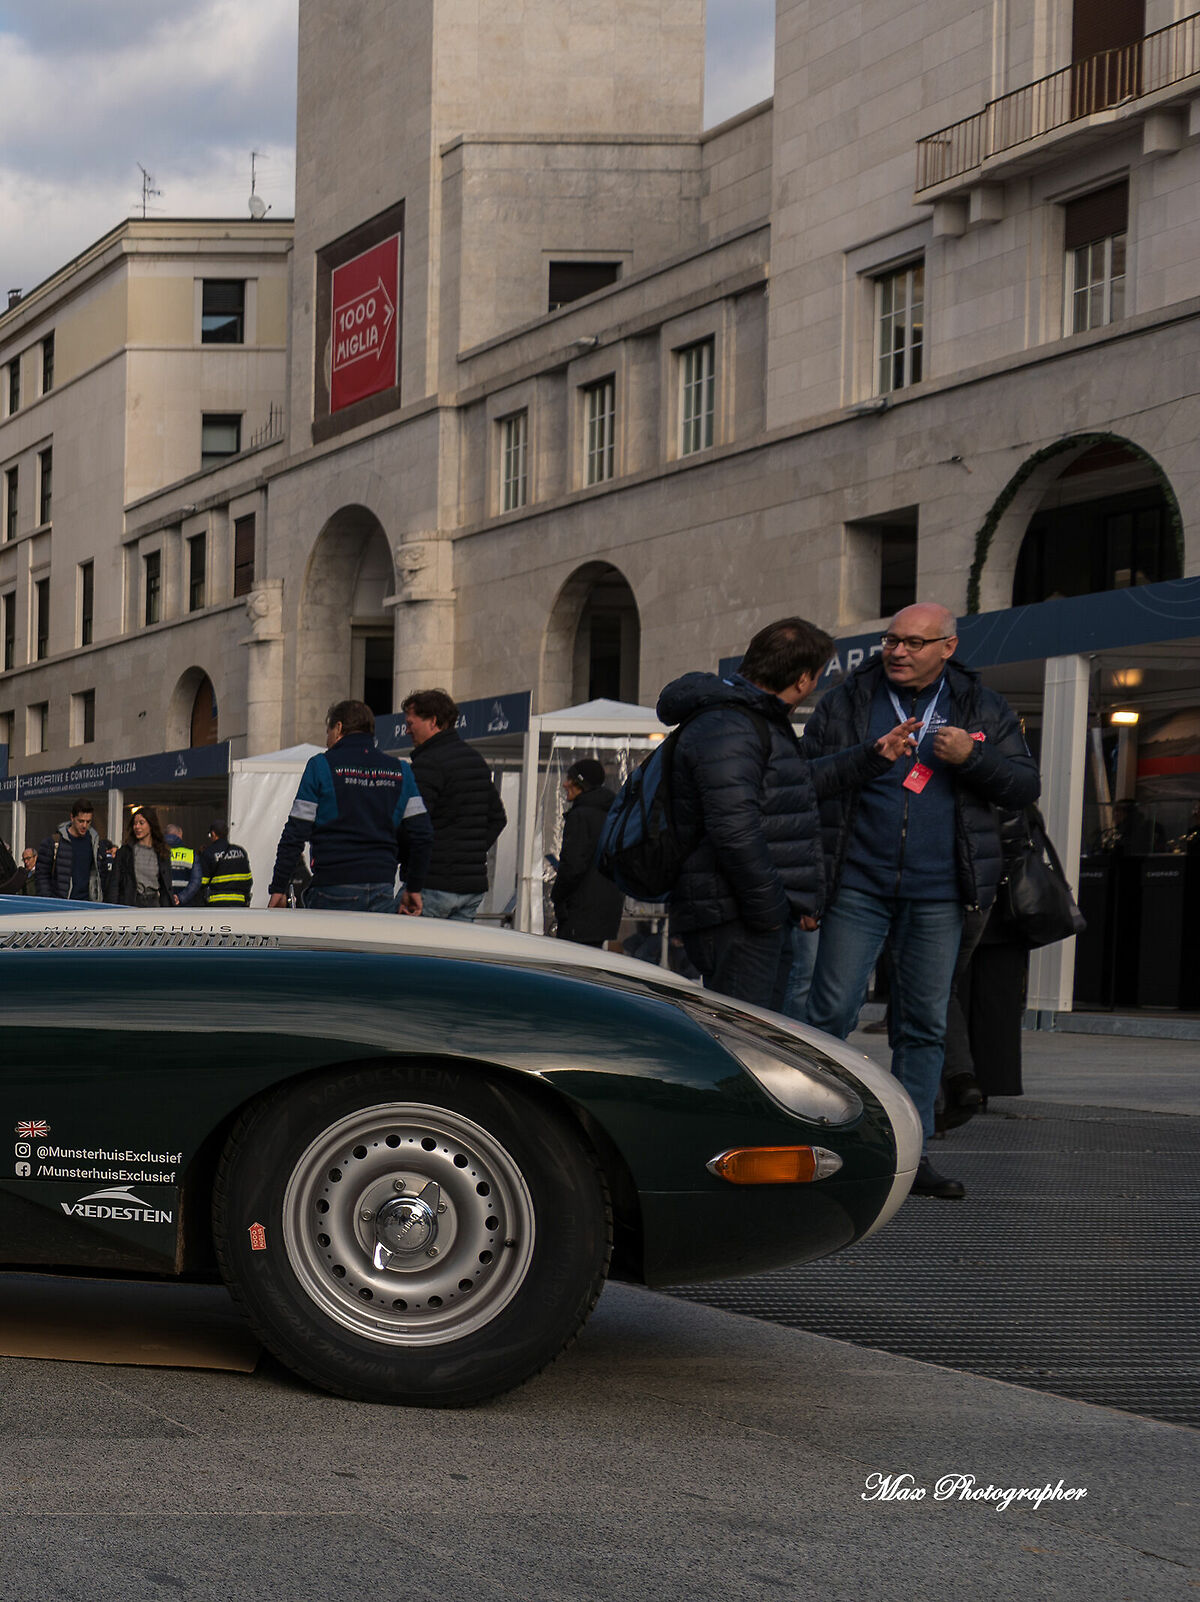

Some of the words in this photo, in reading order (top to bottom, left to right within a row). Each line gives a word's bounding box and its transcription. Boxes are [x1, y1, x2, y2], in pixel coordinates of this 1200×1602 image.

[339, 298, 376, 332] 1000
[337, 324, 379, 363] MIGLIA
[33, 773, 63, 786] SPORTIVE
[70, 767, 105, 782] CONTROLLO
[105, 762, 137, 776] POLIZIA
[44, 925, 233, 933] MUNSTERHUIS
[36, 1145, 182, 1164] @MunsterhuisExclusief
[36, 1165, 176, 1183] /MunsterhuisExclusief
[60, 1202, 173, 1224] VREDESTEIN
